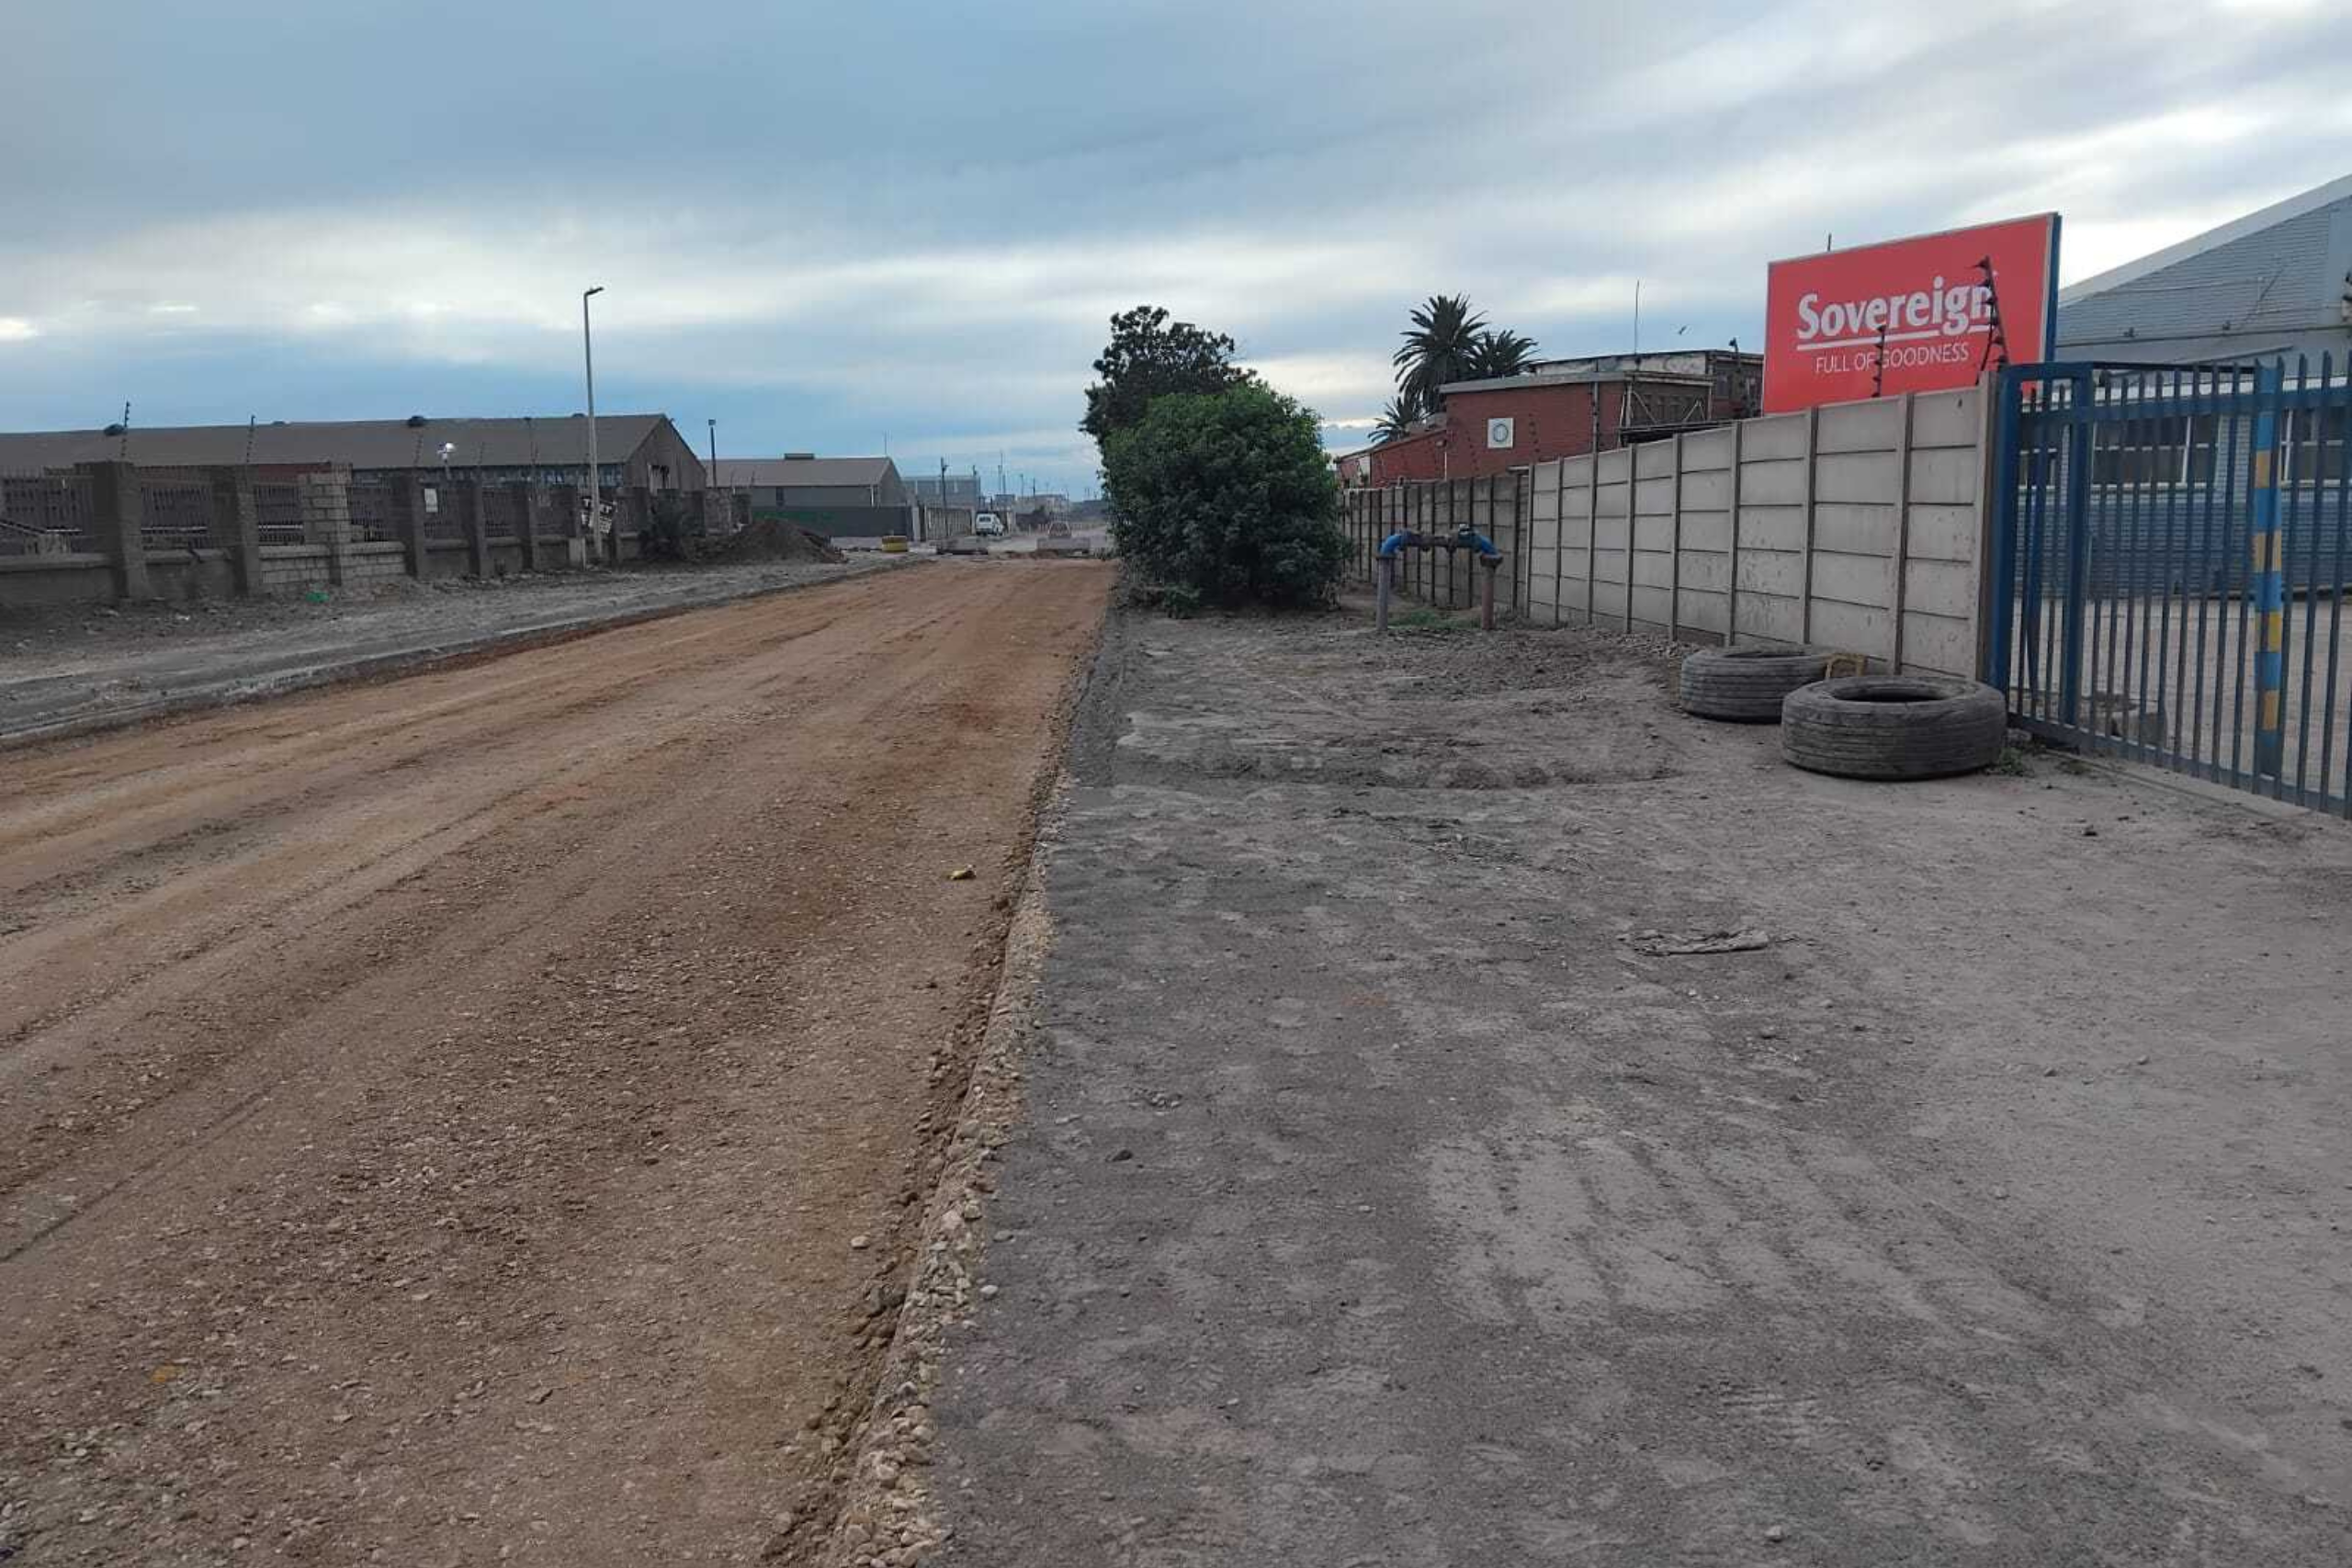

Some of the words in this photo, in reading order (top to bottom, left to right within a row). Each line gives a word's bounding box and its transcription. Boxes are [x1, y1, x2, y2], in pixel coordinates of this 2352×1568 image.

[1796, 276, 1994, 339] Sovereign
[1815, 354, 1850, 374] FULL
[1854, 351, 1877, 371] OF
[1881, 341, 1970, 369] GOODNESS
